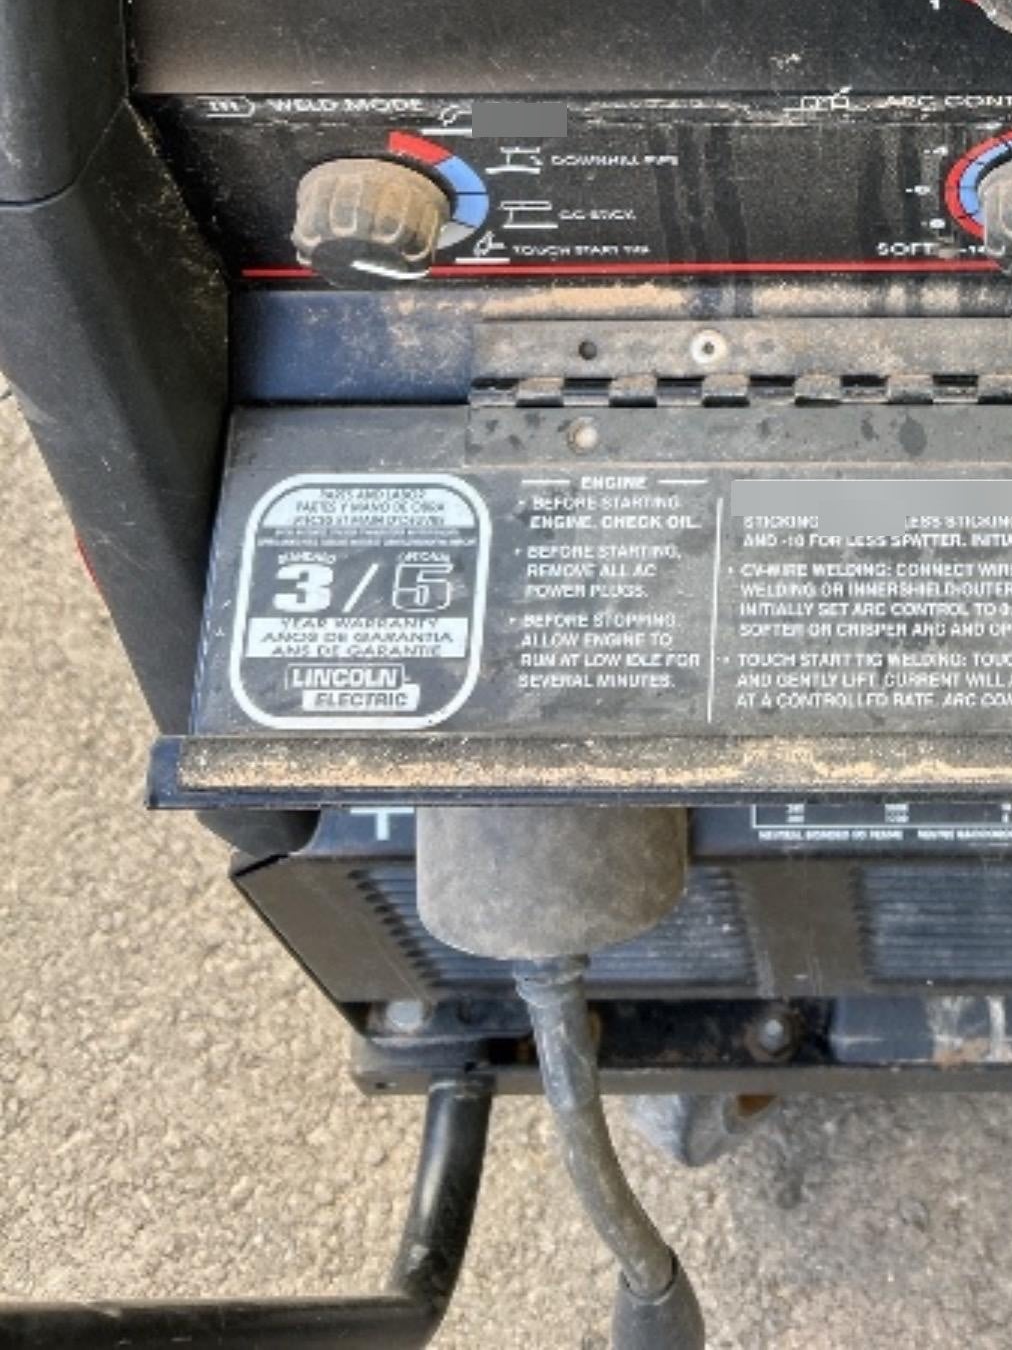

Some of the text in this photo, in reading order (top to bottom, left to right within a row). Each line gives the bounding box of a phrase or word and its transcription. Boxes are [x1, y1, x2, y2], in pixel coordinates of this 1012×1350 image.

[266, 98, 424, 112] WELD MODE
[884, 95, 936, 106] ARC
[551, 154, 641, 167] DOWNHILL
[513, 245, 571, 256] TOUCH
[877, 242, 935, 256] SOFT
[580, 476, 648, 490] ENGINE
[532, 496, 597, 510] BEFORE
[601, 516, 663, 530] CHECK
[742, 533, 778, 547] AND
[527, 545, 595, 559] BEFORE
[527, 564, 658, 577] REMOVE ALL AC
[895, 563, 973, 577] CONNECT
[272, 563, 456, 613] 3 5
[526, 585, 586, 598] POWER
[818, 602, 850, 616] SET
[890, 602, 969, 616] CONTROL
[974, 602, 997, 616] TO
[523, 613, 589, 628] BEFORE
[521, 633, 674, 648] ALLOW ENGINE TO
[520, 653, 700, 668] RUN AT LOW IDLE FOR
[737, 653, 796, 667] TOUCH
[291, 667, 400, 688] LINCOLN
[517, 674, 594, 689] SEVERAL
[965, 672, 1006, 688] WILL
[315, 692, 409, 706] ELECTRIC
[735, 693, 756, 708] AT
